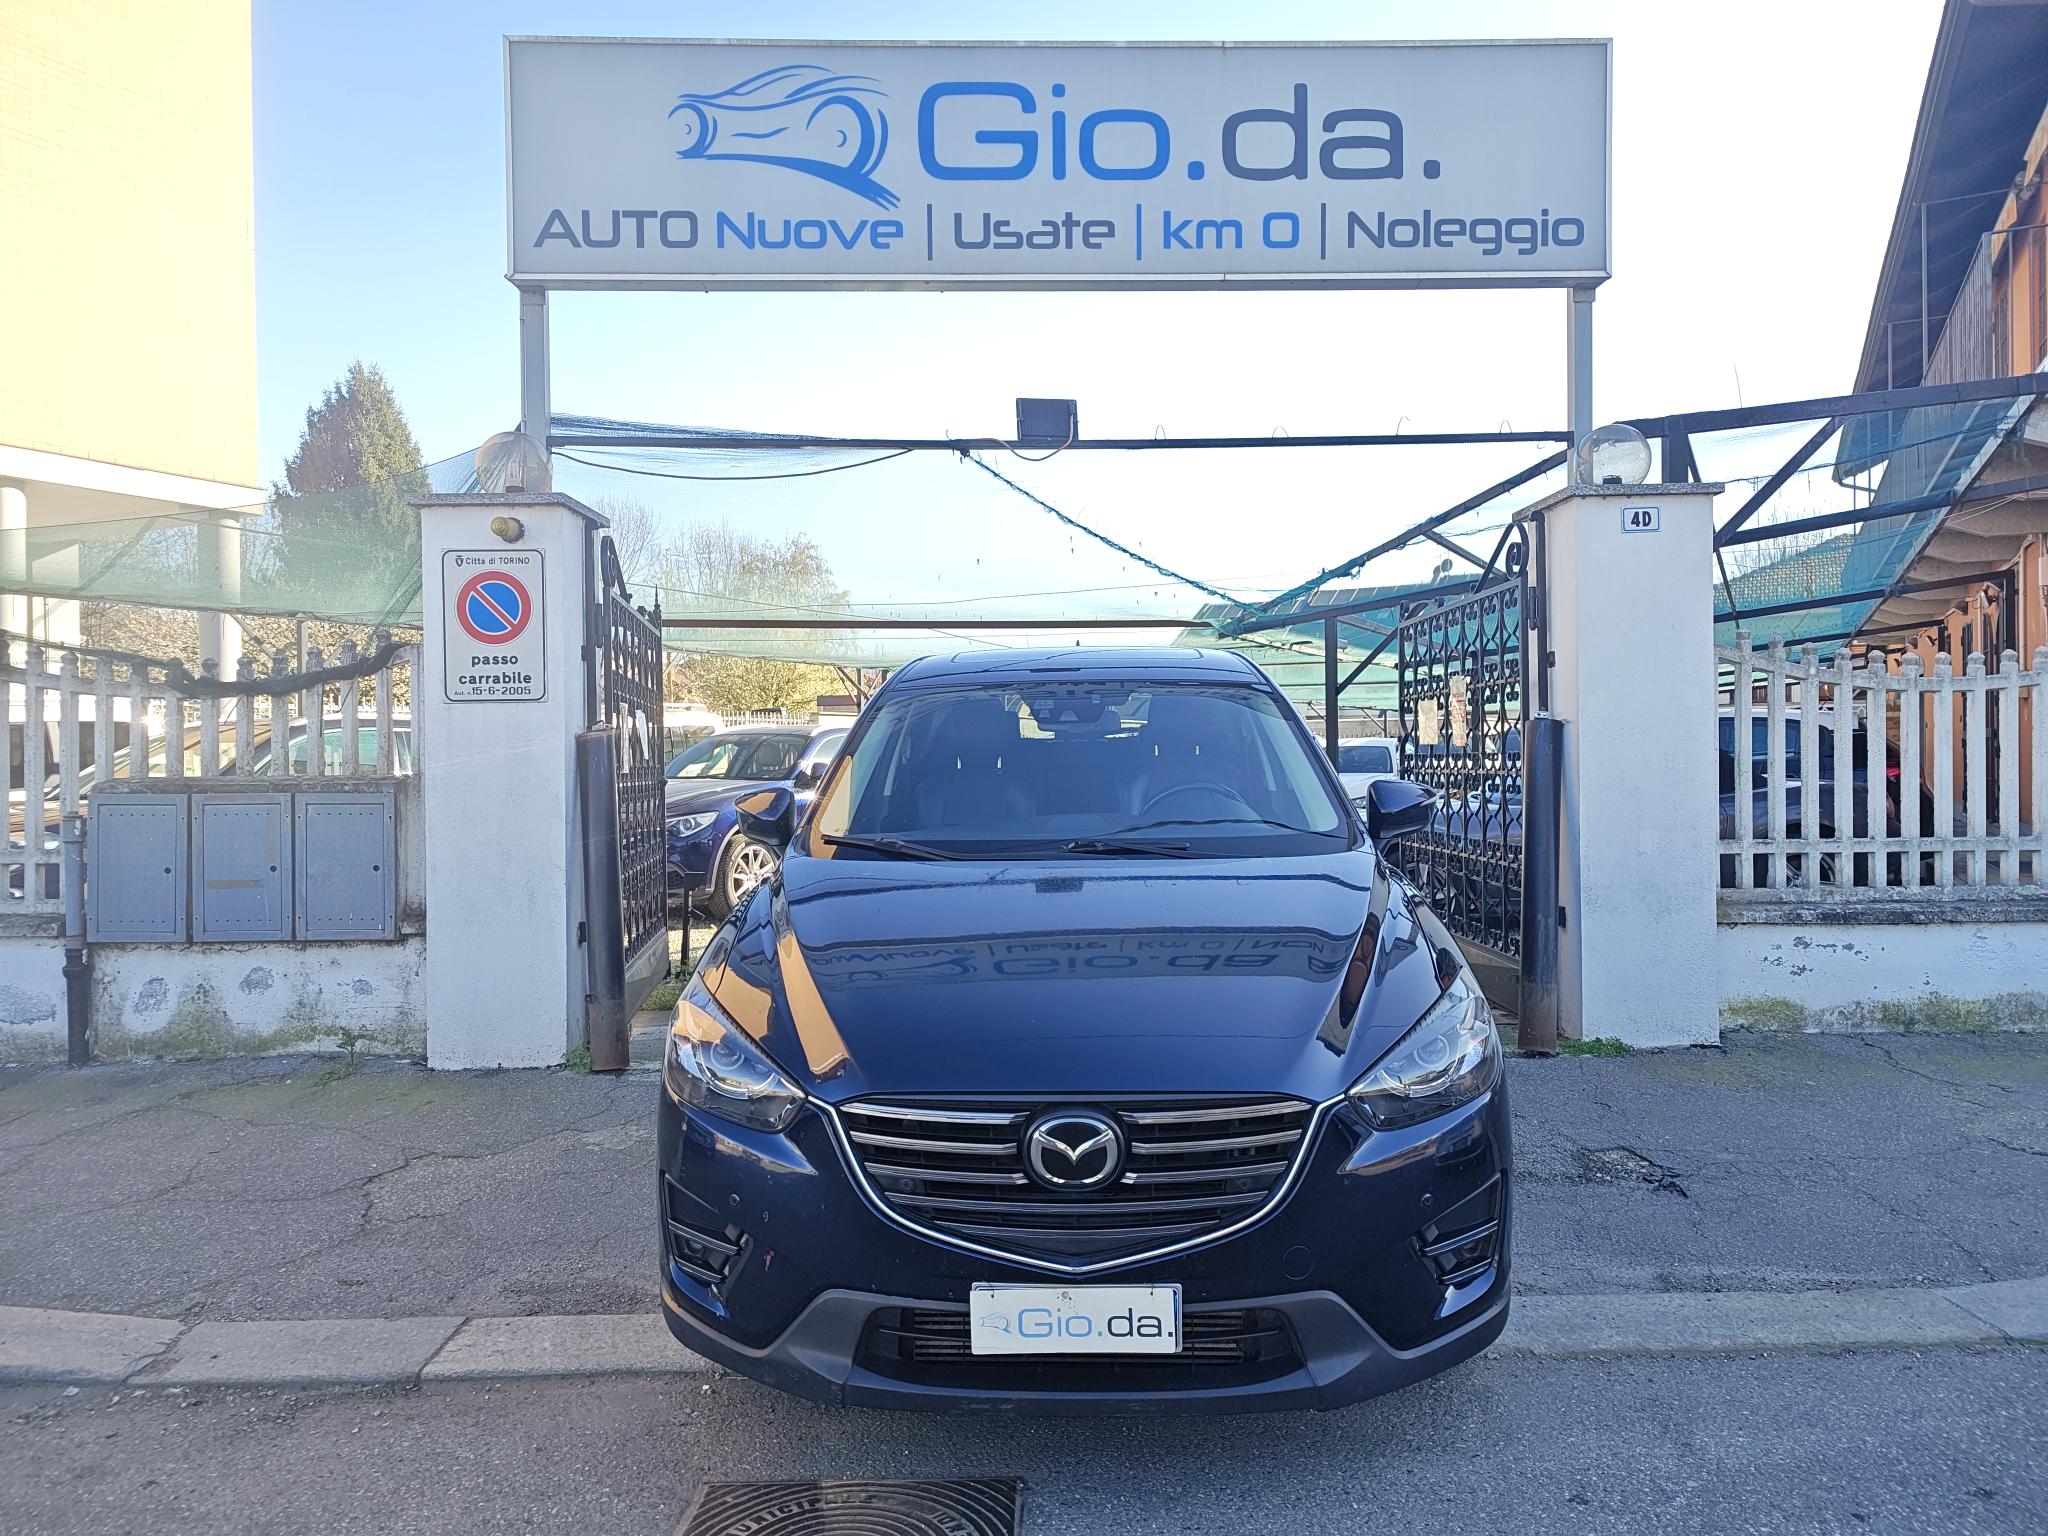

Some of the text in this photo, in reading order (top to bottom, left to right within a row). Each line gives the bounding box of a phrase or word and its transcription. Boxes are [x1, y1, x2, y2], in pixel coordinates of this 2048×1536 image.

[917, 81, 1441, 181] Gio.da.
[533, 208, 698, 248] AUTO
[717, 211, 903, 249] Nuove
[955, 210, 1115, 250] Usate
[1163, 210, 1243, 249] km
[1348, 208, 1585, 256] Noleggio
[1630, 511, 1652, 527] 4D
[488, 556, 496, 565] di
[498, 556, 530, 565] TORINO
[471, 654, 519, 668] passo
[458, 671, 532, 685] carrabile
[472, 686, 532, 696] 15-6-2005
[1017, 1307, 1174, 1339] Gio.da.
